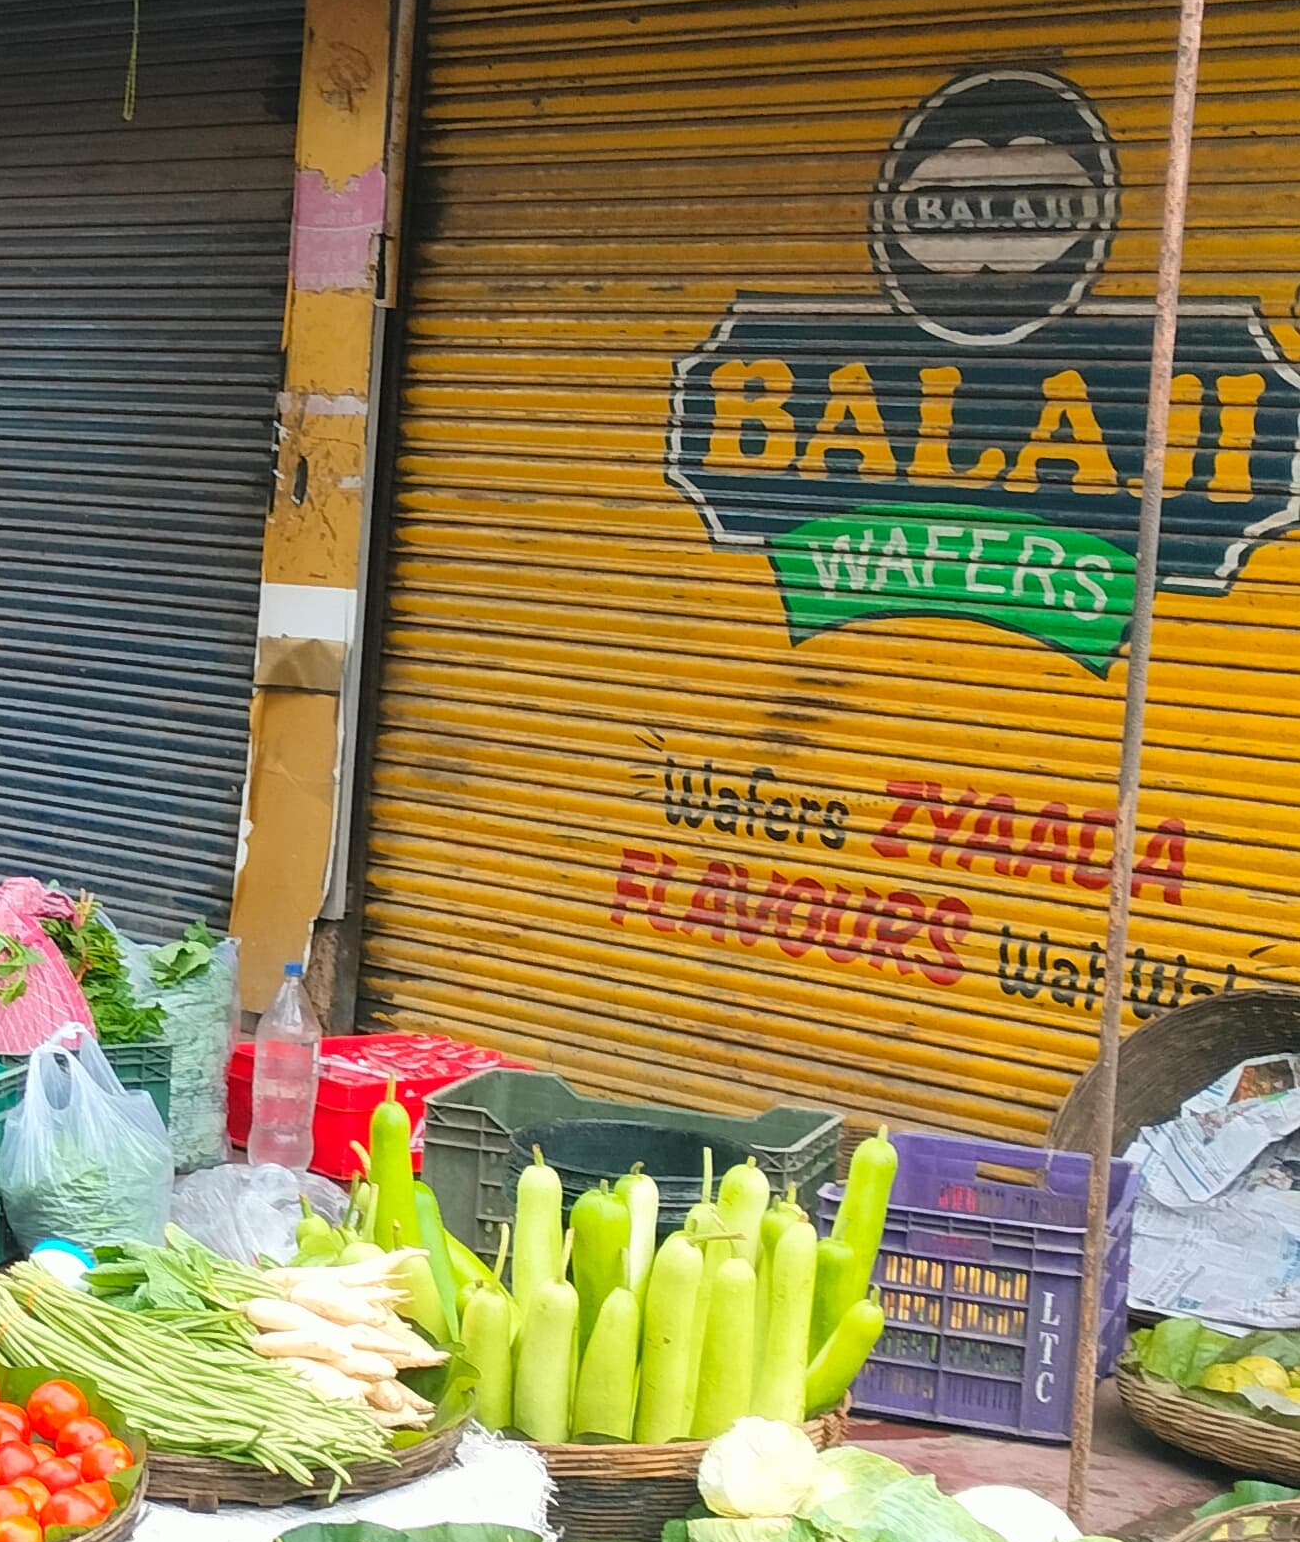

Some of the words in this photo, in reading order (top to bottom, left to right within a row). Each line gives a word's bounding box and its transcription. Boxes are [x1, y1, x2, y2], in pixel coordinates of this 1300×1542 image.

[912, 194, 1073, 229] BALAJI
[701, 358, 1267, 504] BALAJI
[808, 525, 1115, 622] WAFERS
[663, 757, 851, 851] Wafers
[610, 848, 974, 987] FLAVOURS
[1034, 1290, 1061, 1404] LTC
